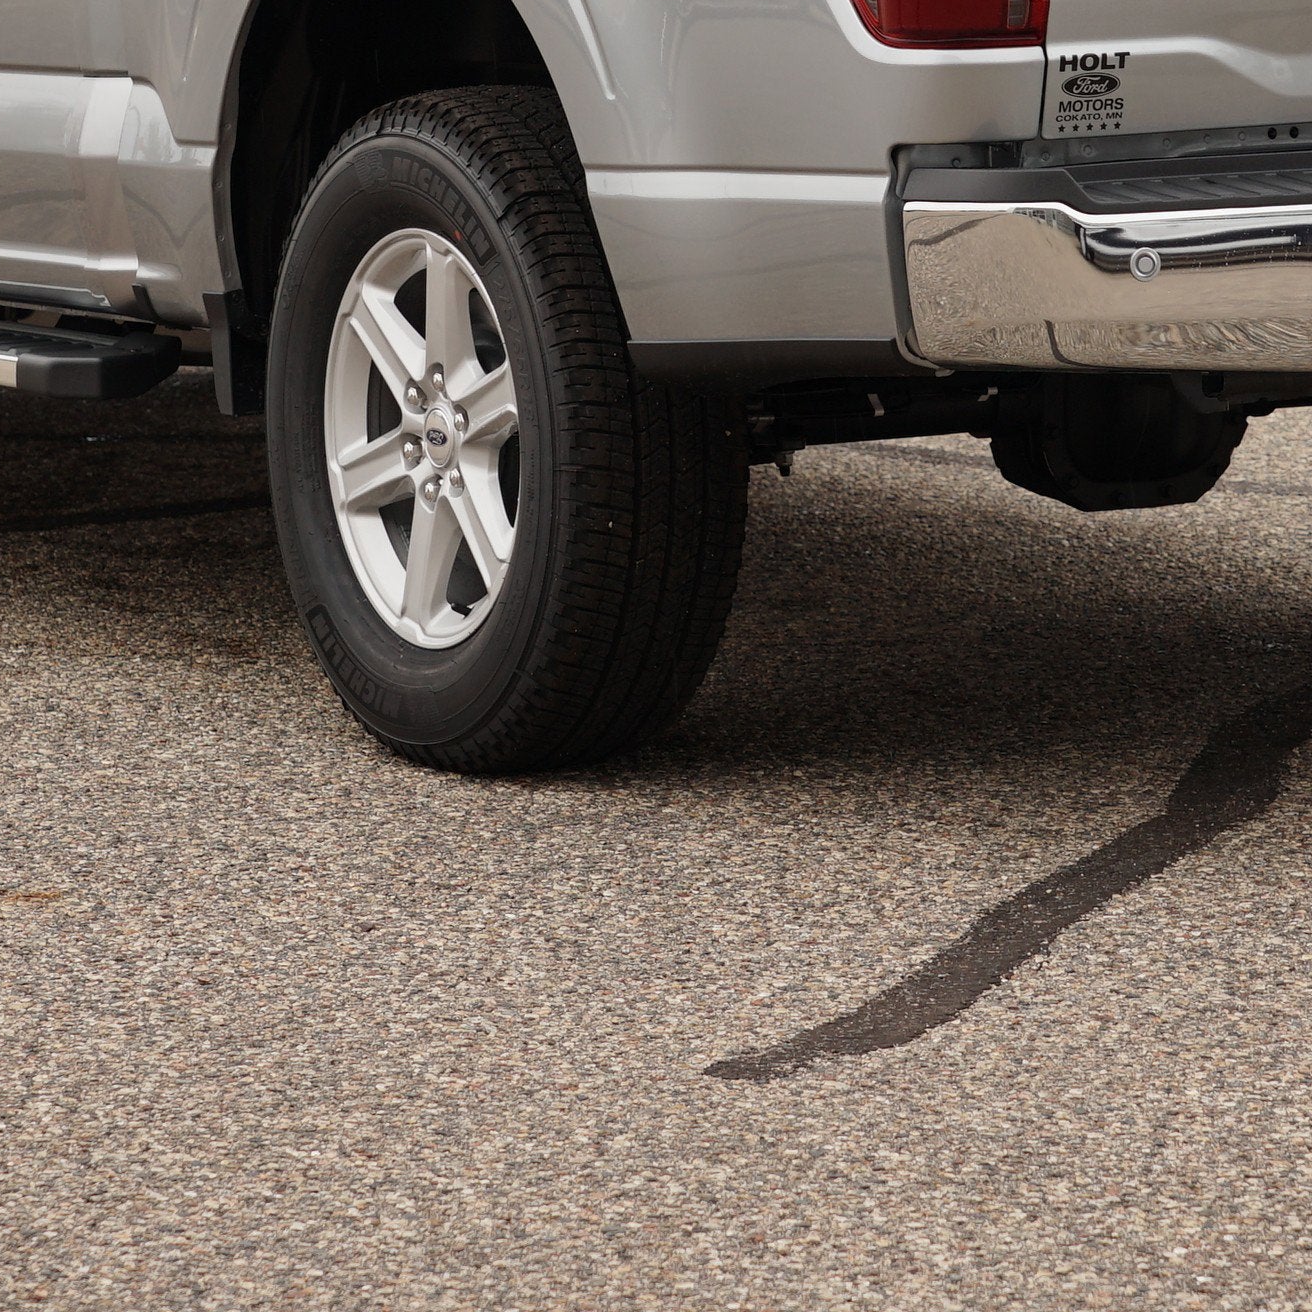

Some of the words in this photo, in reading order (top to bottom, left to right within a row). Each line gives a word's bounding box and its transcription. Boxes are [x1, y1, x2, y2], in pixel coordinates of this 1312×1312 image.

[1059, 52, 1130, 72] HOLT
[1073, 76, 1109, 94] Ford
[1058, 98, 1124, 113] MOTORS
[1055, 113, 1103, 123] COKATO,
[1106, 111, 1123, 120] MN
[393, 156, 494, 262] MICHELIN
